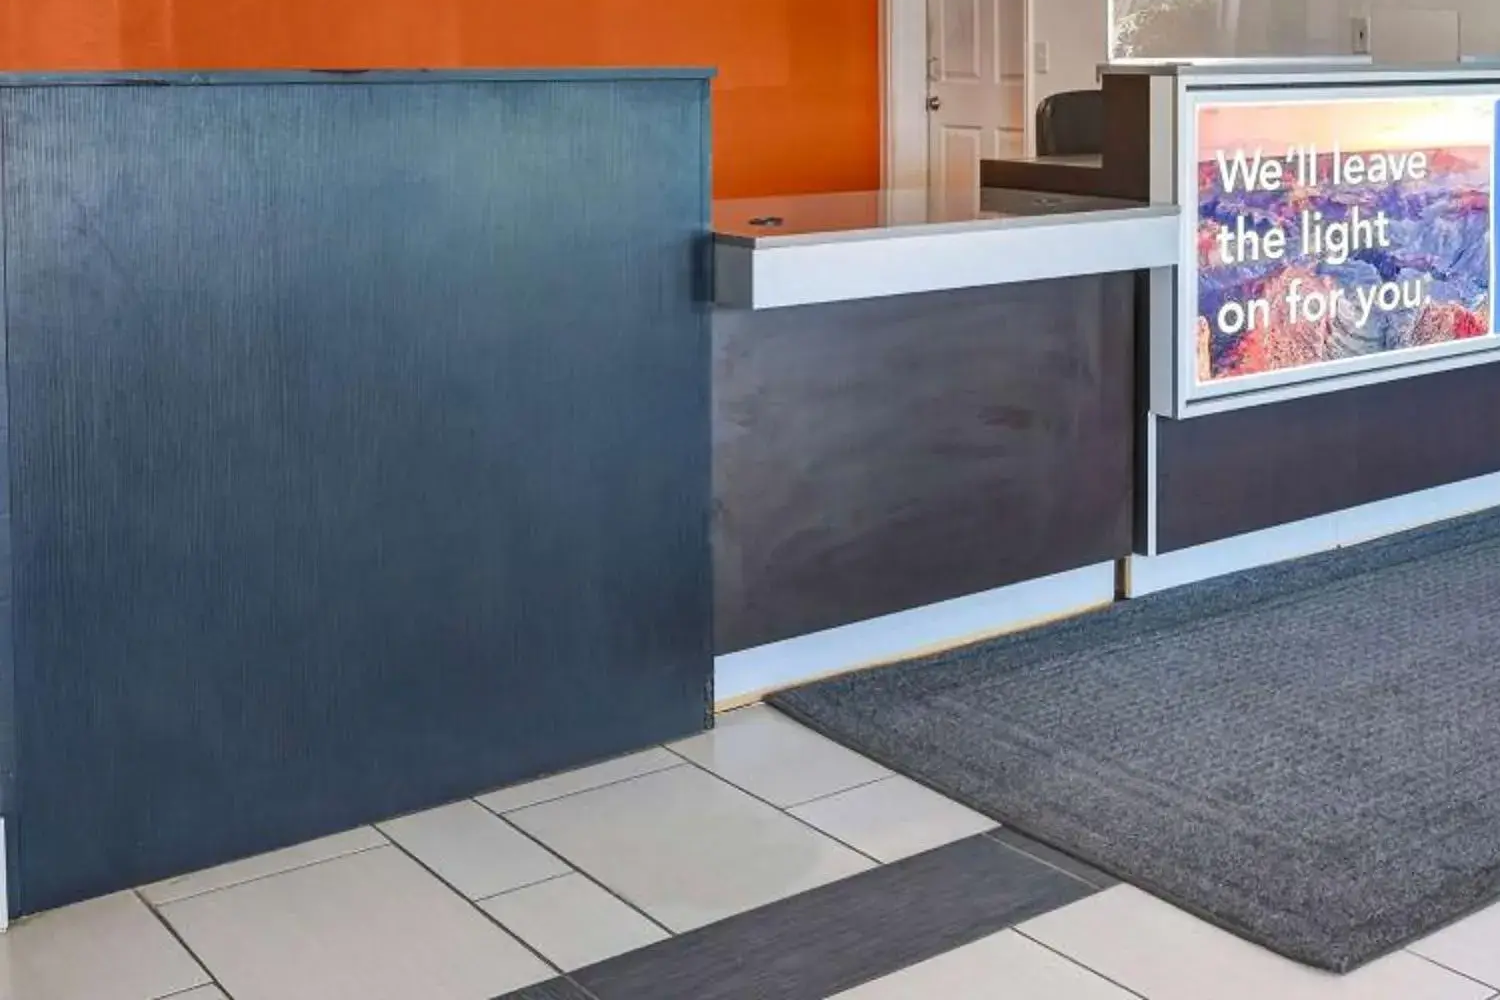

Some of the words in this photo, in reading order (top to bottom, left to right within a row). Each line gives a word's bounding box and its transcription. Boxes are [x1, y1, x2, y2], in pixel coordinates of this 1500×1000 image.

[1333, 140, 1427, 186] leave
[1216, 215, 1286, 264] the
[1302, 206, 1391, 265] light
[1217, 299, 1270, 334] on
[1286, 278, 1344, 324] for
[1356, 278, 1431, 328] you.
